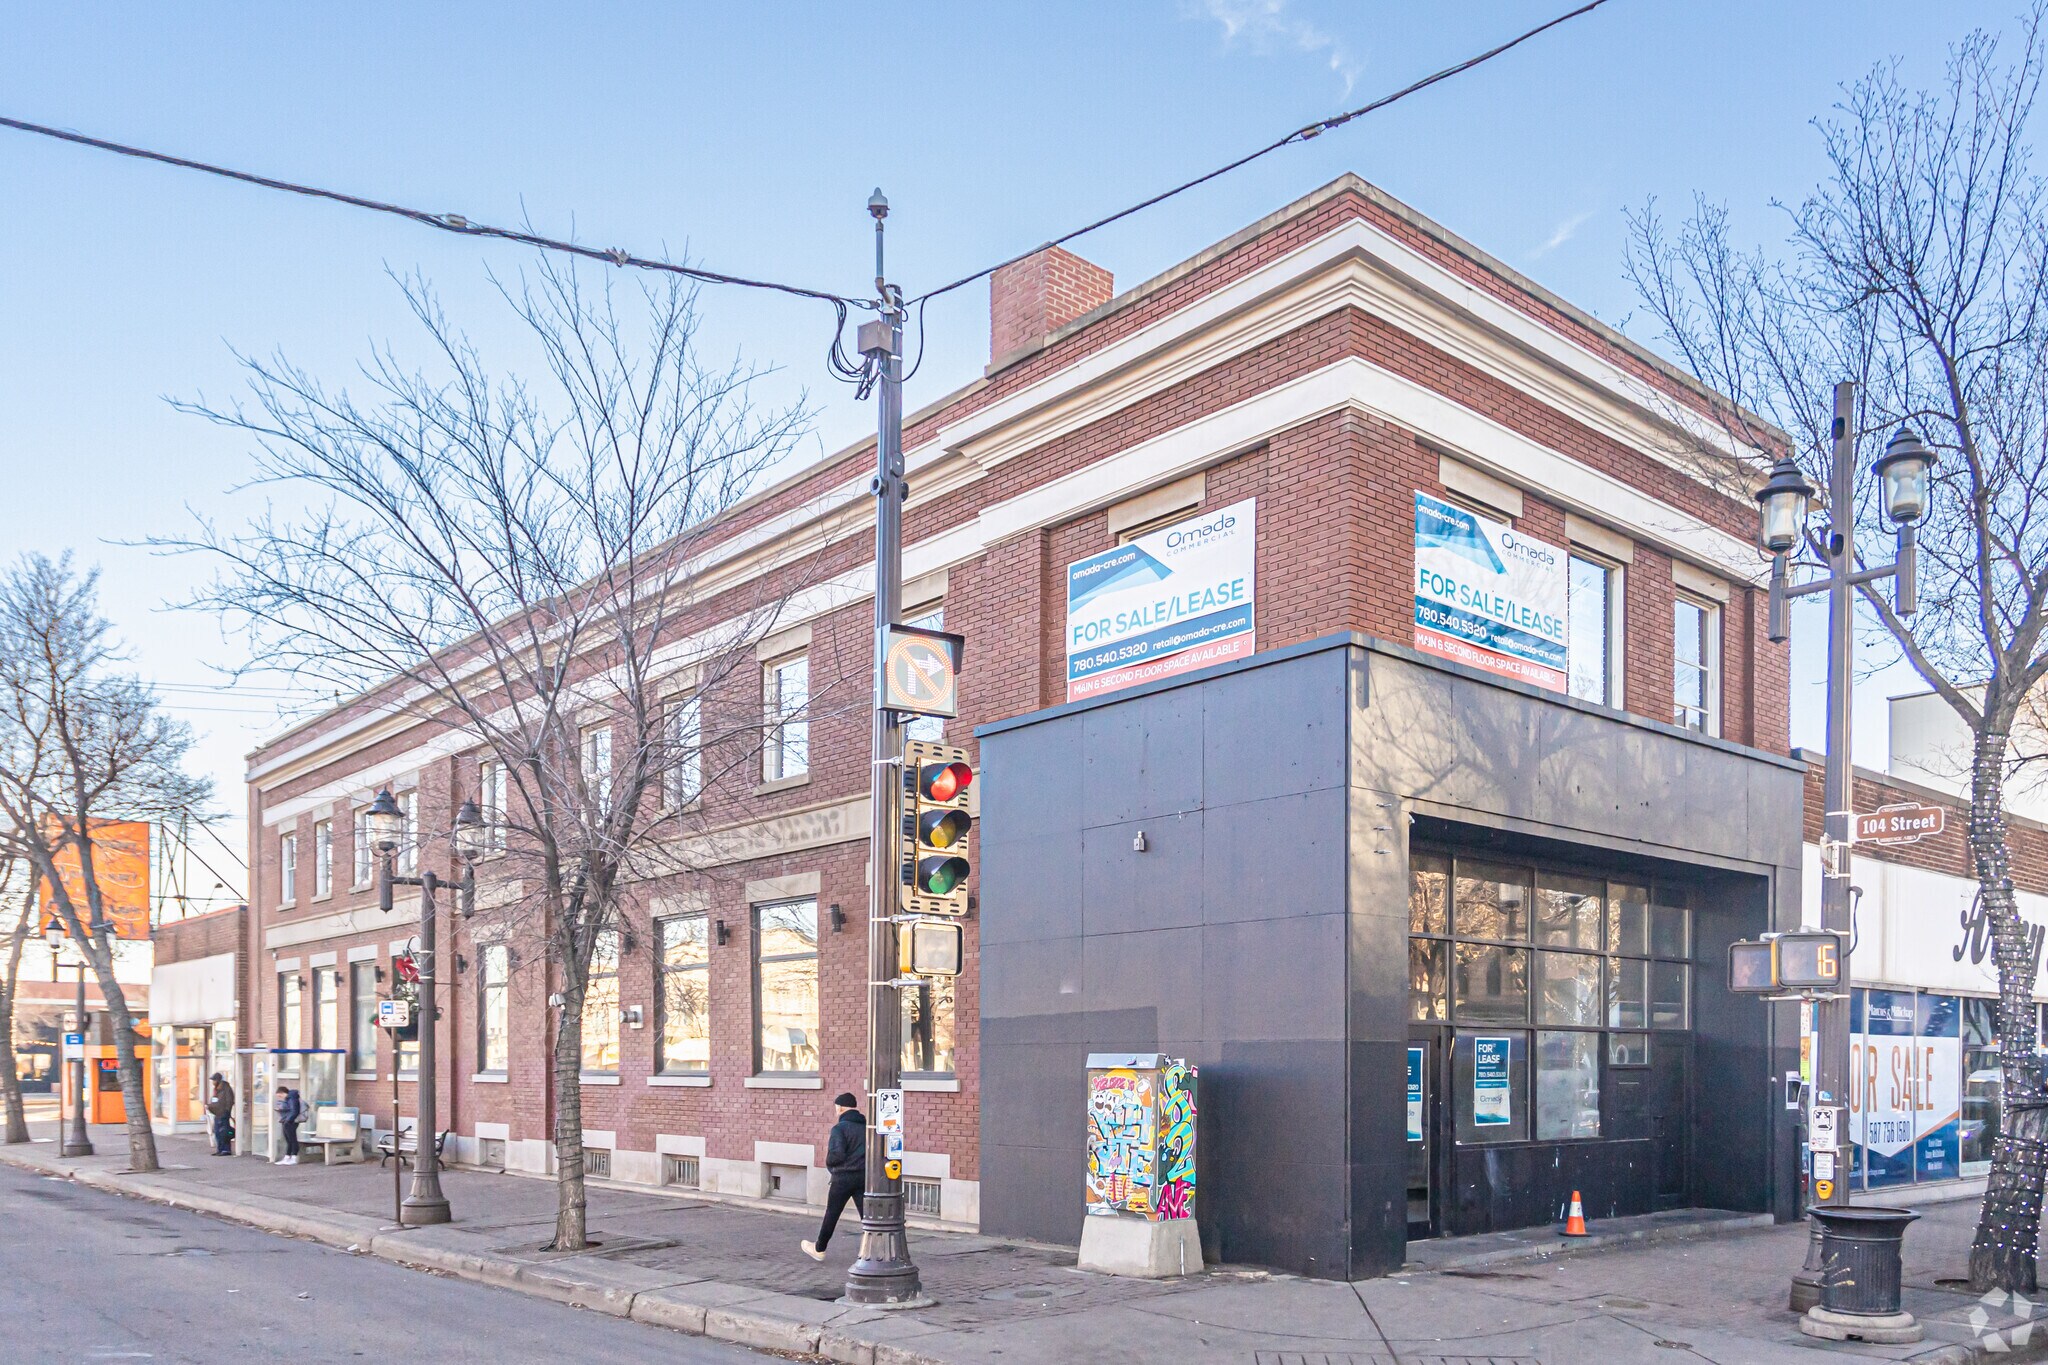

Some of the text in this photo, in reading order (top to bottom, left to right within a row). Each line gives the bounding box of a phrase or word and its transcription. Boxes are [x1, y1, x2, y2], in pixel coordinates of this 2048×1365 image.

[1166, 514, 1236, 548] Omada
[1417, 504, 1470, 531] omada-cre.com
[1166, 530, 1235, 557] COMMERCIAL
[1501, 533, 1555, 566] Omada
[1072, 552, 1136, 580] omada-cre.com
[1073, 578, 1244, 646] FOR SALE/LEASE
[1420, 568, 1563, 640] FOR SALE/LEASE
[1074, 617, 1246, 673] 780.540.5320 retail@omada-cre.com
[1418, 605, 1563, 663] 780.540.5320 retail@omada-cre.com
[1074, 680, 1094, 695] MAIN
[1100, 669, 1134, 688] SECOND
[1134, 662, 1163, 679] FLOOR
[1163, 655, 1190, 672] SPACE
[1190, 641, 1239, 665] AVAILABLE
[1417, 632, 1437, 650] MAIN
[1444, 641, 1471, 660] SECOND
[1472, 651, 1495, 668] FLOOR
[1495, 657, 1520, 674] SPACE
[1521, 663, 1556, 685] AVAILABLE
[1862, 814, 1936, 834] 104 Street
[1817, 944, 1837, 977] 16
[1478, 1044, 1493, 1053] FOR
[1478, 1054, 1500, 1064] LEASE
[1850, 1043, 1934, 1113] OR SALE
[1870, 1122, 1881, 1144] 587
